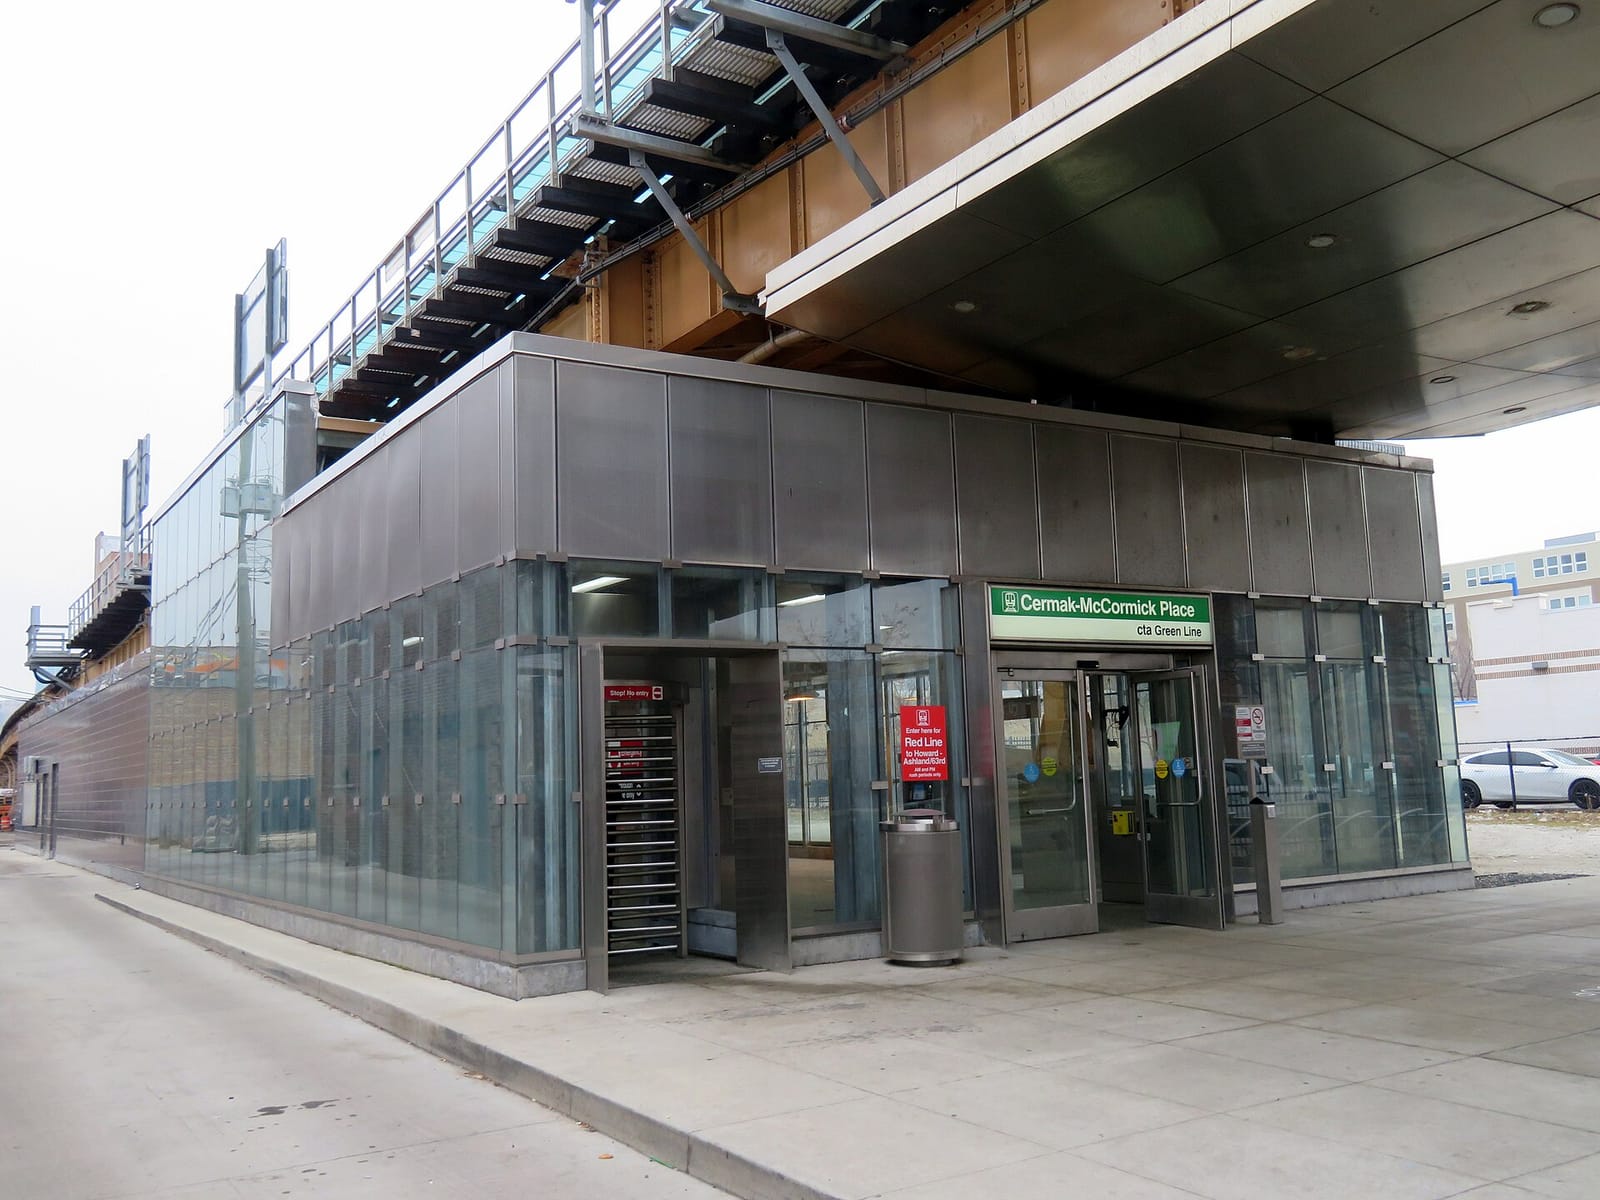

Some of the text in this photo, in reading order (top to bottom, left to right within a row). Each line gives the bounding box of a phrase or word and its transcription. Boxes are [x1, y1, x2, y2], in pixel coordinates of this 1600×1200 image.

[1021, 594, 1195, 617] Cermak-McCormick Place
[1137, 624, 1202, 637] cta Green Line
[905, 737, 943, 747] Red Line
[914, 749, 939, 757] Howard
[904, 757, 946, 765] Ashland/63rd
